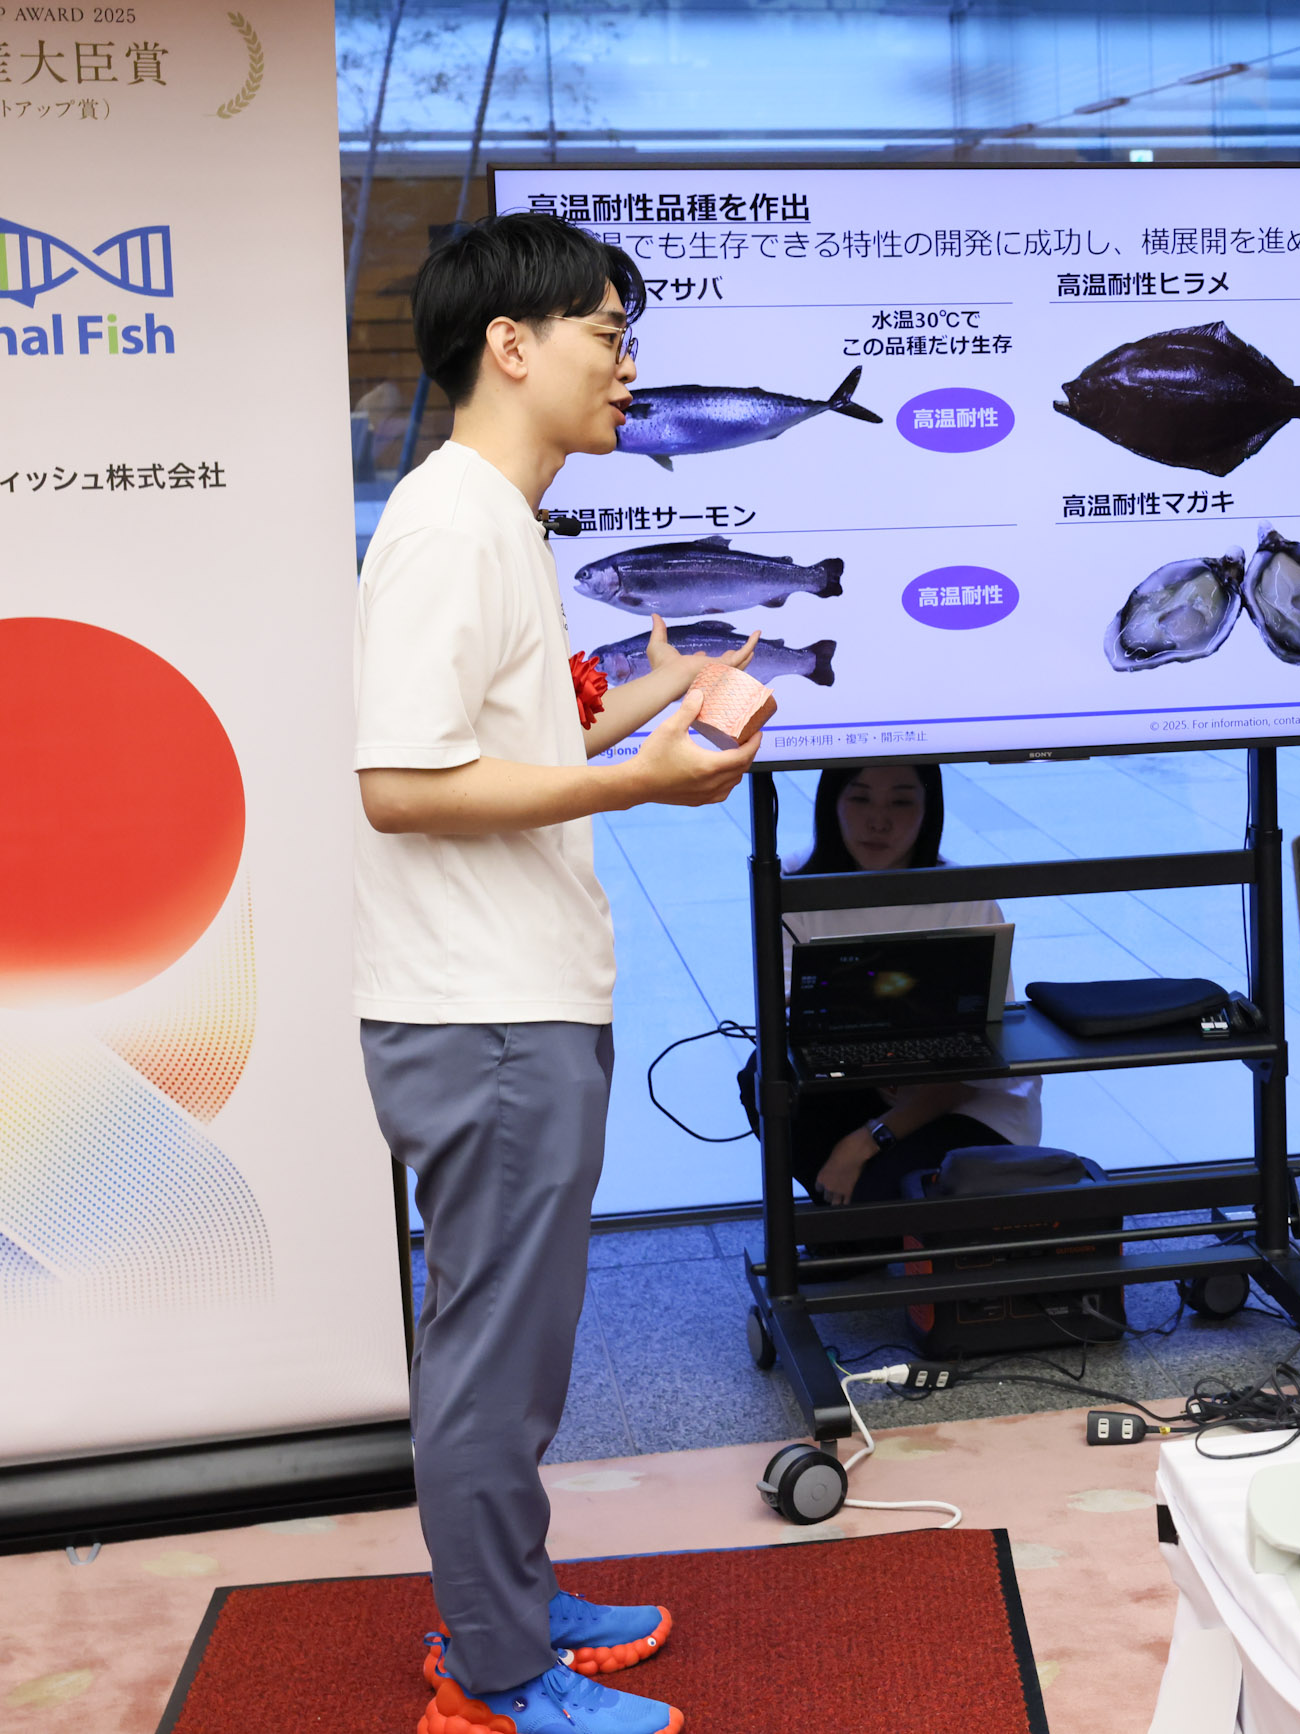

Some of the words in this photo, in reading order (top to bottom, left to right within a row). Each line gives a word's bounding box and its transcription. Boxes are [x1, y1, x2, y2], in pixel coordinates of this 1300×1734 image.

[15, 7, 84, 22] AWARD
[93, 8, 136, 23] 2025
[0, 39, 169, 86] 大臣賞
[527, 193, 810, 223] 高温耐性品種を作出
[644, 275, 723, 301] マサバ
[1056, 271, 1230, 297] 高温耐性ヒラメ
[871, 309, 980, 331] 水温30℃で
[78, 312, 175, 355] Fish
[842, 334, 1013, 357] この品種だけ生存
[912, 407, 999, 430] 高温耐性
[0, 461, 227, 493] ィッシュ株式会社
[1062, 489, 1235, 518] 高温耐性マガキ
[918, 584, 1003, 608] 高温耐性
[1162, 719, 1190, 731] 2025.
[1192, 718, 1208, 730] For
[1211, 717, 1271, 729] information,
[774, 730, 928, 749] 目的外利用・複写・開示禁止
[1029, 751, 1053, 759] SONY
